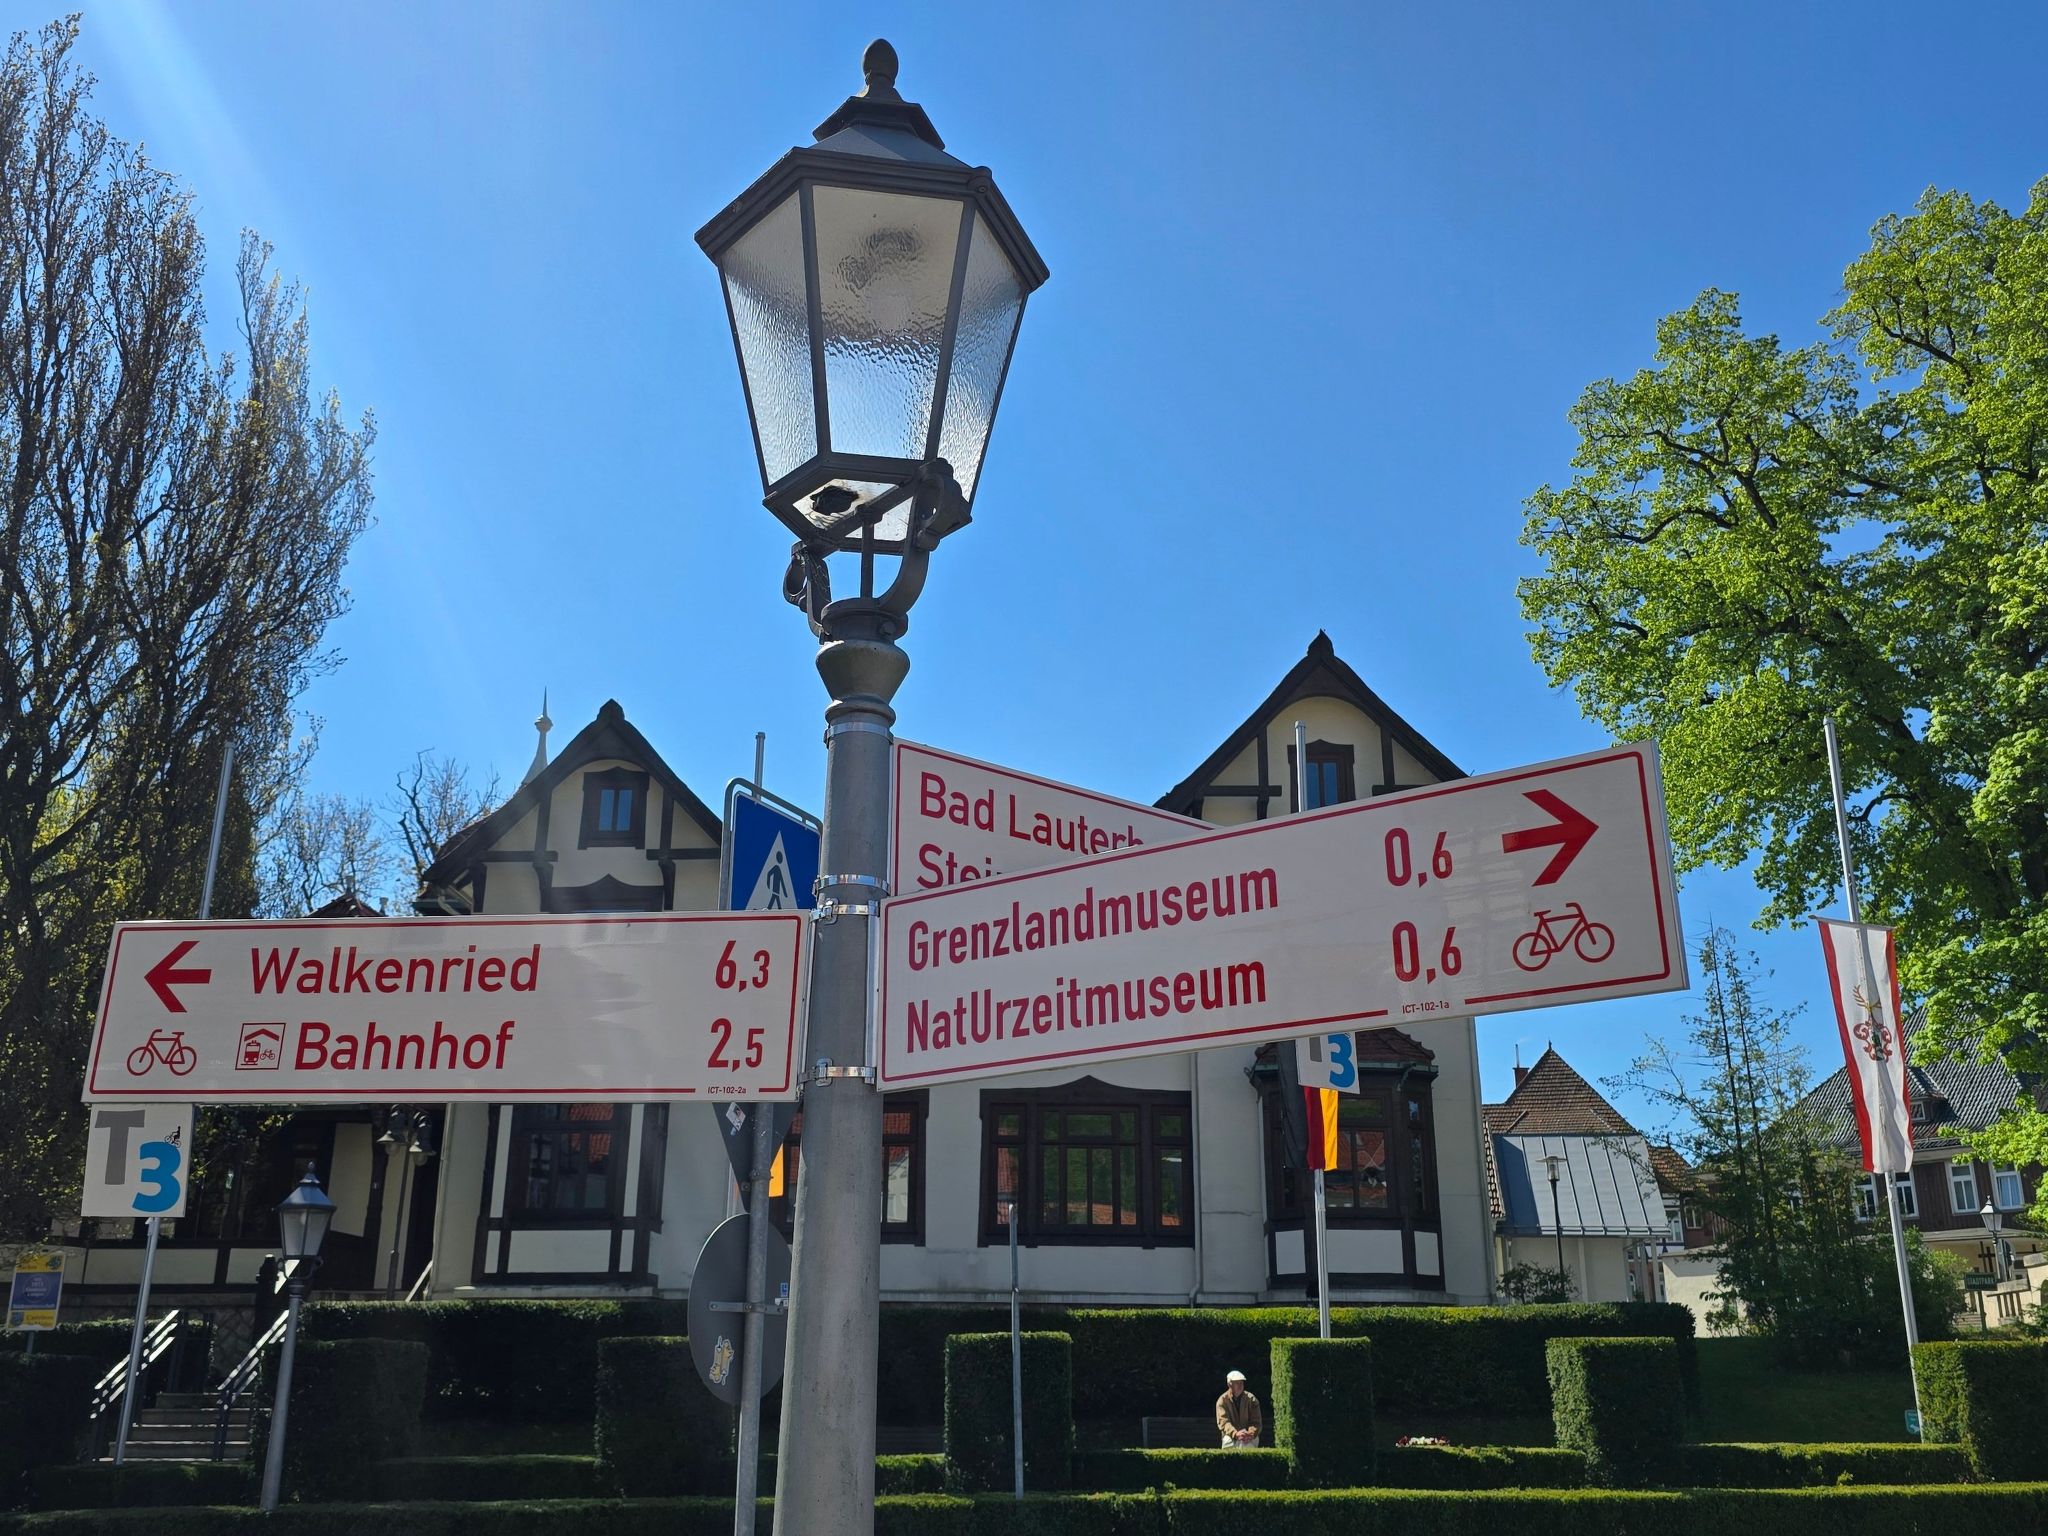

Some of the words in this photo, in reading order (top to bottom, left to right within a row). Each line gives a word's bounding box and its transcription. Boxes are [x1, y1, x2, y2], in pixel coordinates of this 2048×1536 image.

[920, 771, 994, 832] Bad
[908, 868, 1278, 971] Grenzlandmuseum
[1385, 827, 1453, 888] 0,6
[250, 943, 541, 993] Walkenried
[715, 940, 770, 992] 6,3
[906, 961, 1266, 1053] NatUrzeitmuseum
[1393, 920, 1462, 984] 0,6
[1402, 1000, 1450, 1014] ICT-102-1a
[294, 1020, 515, 1070] Bahnhof
[707, 1018, 765, 1072] 2,5
[707, 1086, 747, 1094] ICT-102-2a
